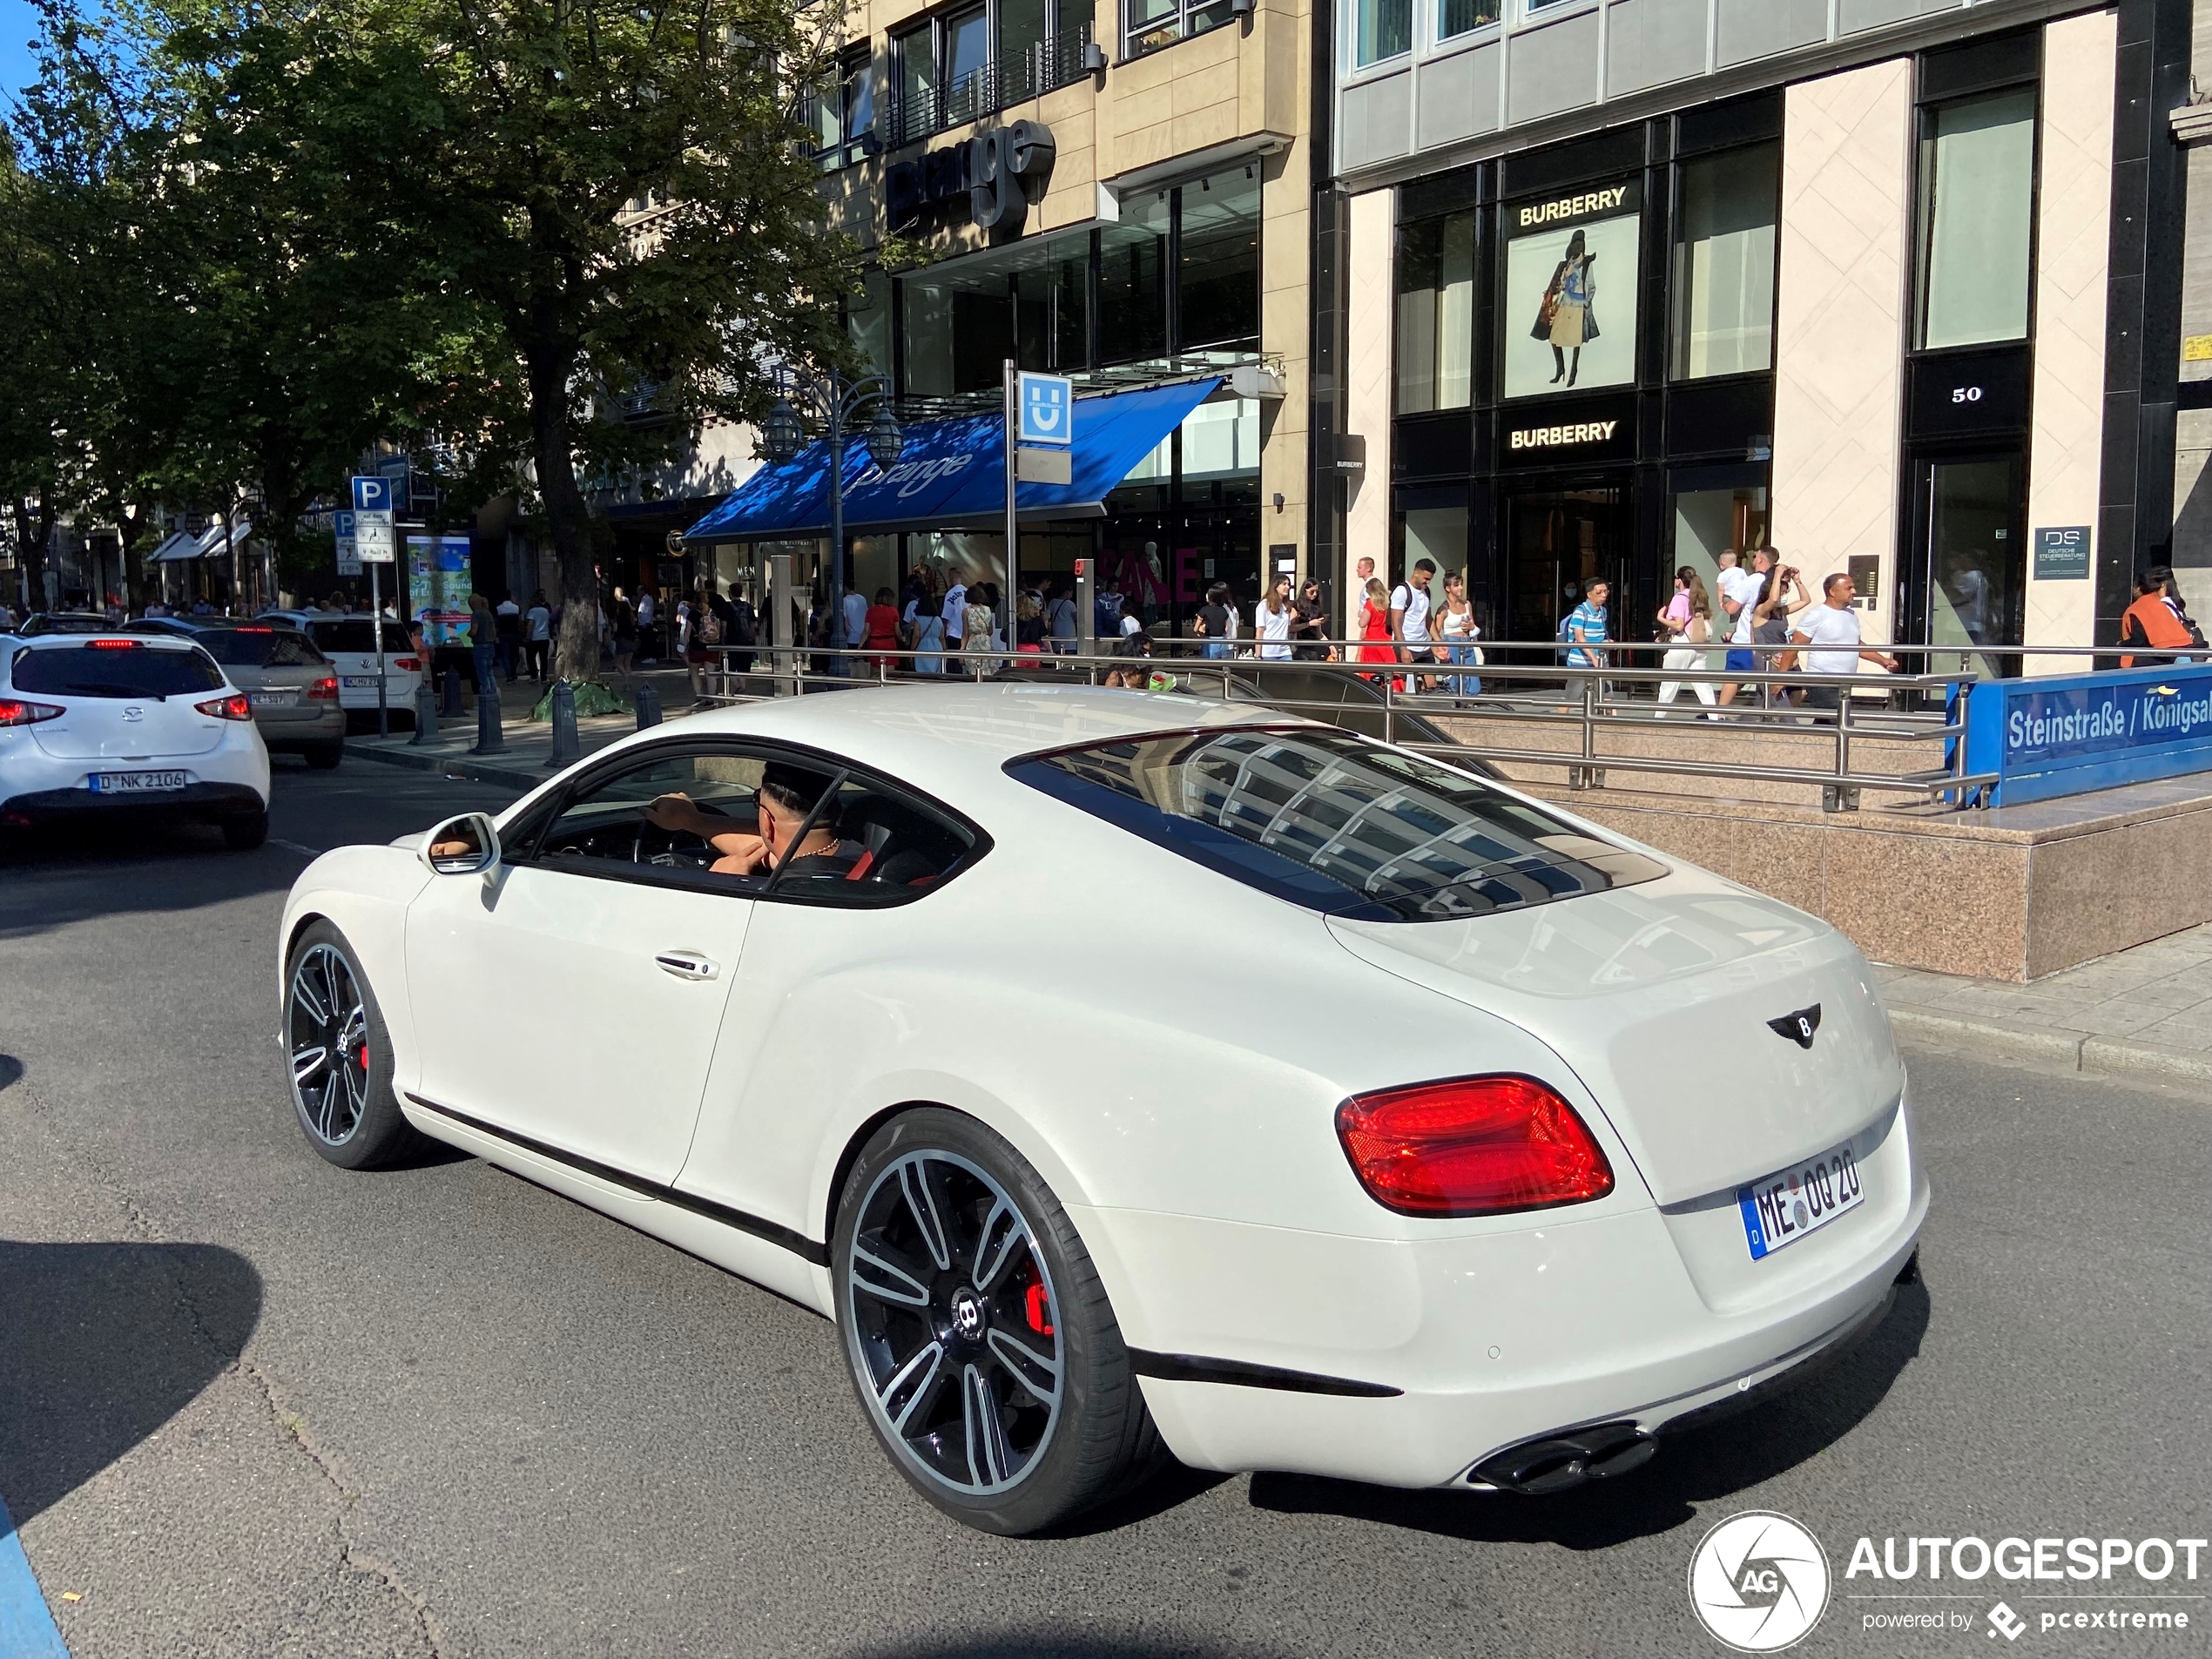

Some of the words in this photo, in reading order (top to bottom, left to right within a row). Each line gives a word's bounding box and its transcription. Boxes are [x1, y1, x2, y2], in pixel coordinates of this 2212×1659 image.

[1520, 186, 1627, 226] BURBERRY
[1952, 387, 1981, 403] 50
[1511, 421, 1616, 448] BURBERRY
[841, 454, 973, 498] prange
[361, 482, 381, 508] P
[2045, 530, 2080, 545] DS
[737, 566, 756, 577] MEN
[2009, 700, 2125, 748] Steinstraße
[2129, 698, 2138, 737] /
[120, 775, 141, 788] NK
[145, 772, 182, 787] 2106
[1757, 1182, 1795, 1243] ME
[1831, 1149, 1859, 1204] 20
